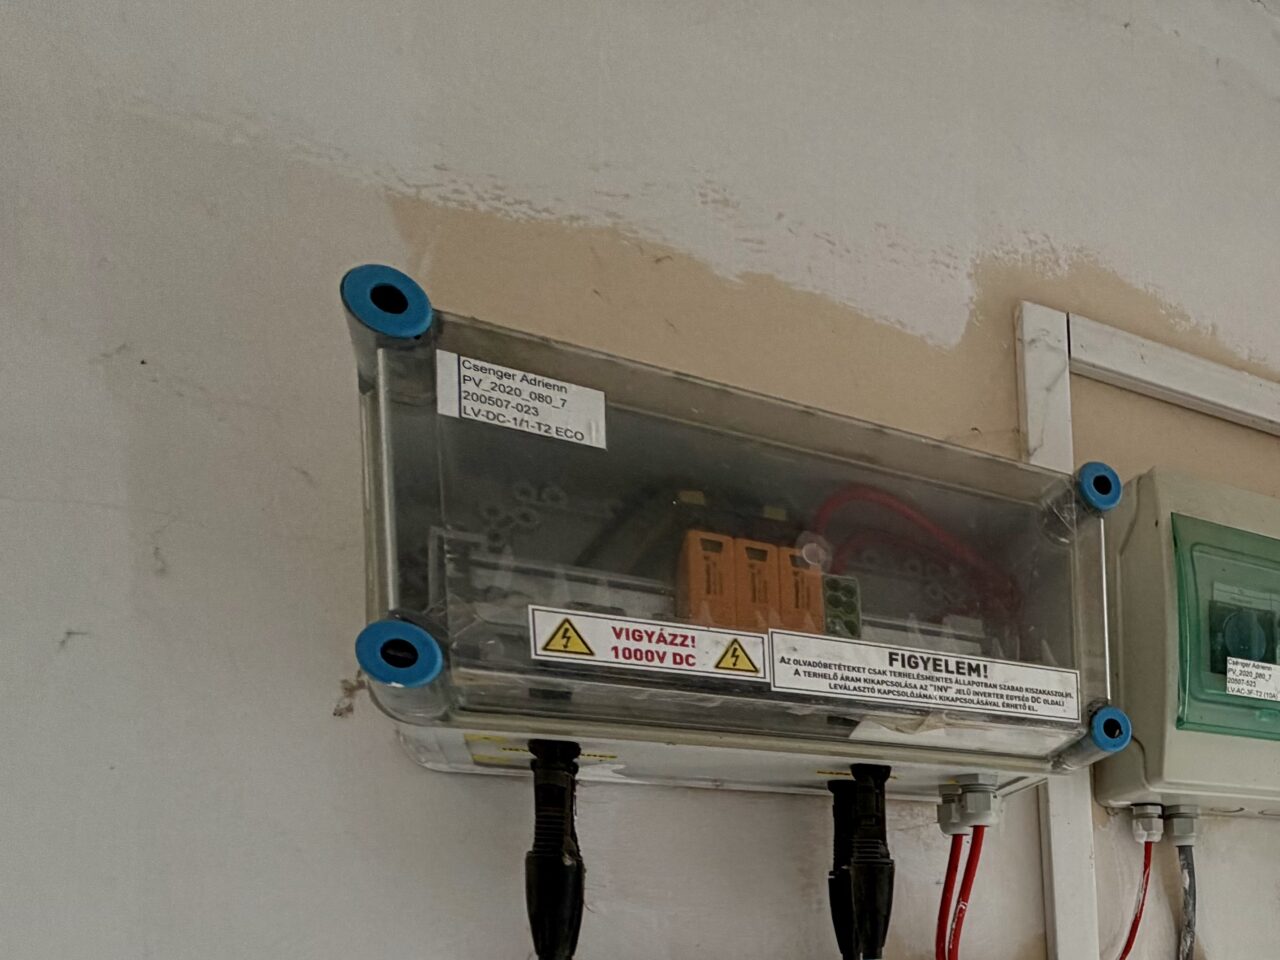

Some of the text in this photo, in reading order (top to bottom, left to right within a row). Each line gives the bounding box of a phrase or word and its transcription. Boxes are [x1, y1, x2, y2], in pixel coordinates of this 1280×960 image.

[462, 359, 568, 394] Csenger Adrienn
[463, 374, 567, 409] PV_2020_080_7
[463, 390, 539, 416] 200507-023
[463, 405, 585, 441] LV-DC-1/1-T2 ECO
[611, 626, 696, 649] VIGYÁZZ!
[611, 645, 696, 667] 1000V DC
[888, 651, 988, 679] FIGYELEM!
[793, 659, 866, 674] OLVADÓBETÉTEKET
[868, 668, 887, 677] CSAK
[889, 670, 953, 685] TERHELÉSMENTES
[954, 677, 998, 690] ÁLLAPOTBAN
[999, 684, 1024, 694] SZABAD
[794, 668, 801, 677] A
[803, 670, 838, 681] TERHELŐ
[840, 674, 862, 684] ÁRAM
[863, 678, 917, 691] KIKAPCSOLÁSA
[919, 684, 928, 692] AZ
[972, 691, 1005, 701] INVERTER
[1031, 695, 1042, 705] DC
[829, 682, 876, 695] LEVÁLASZTÓ
